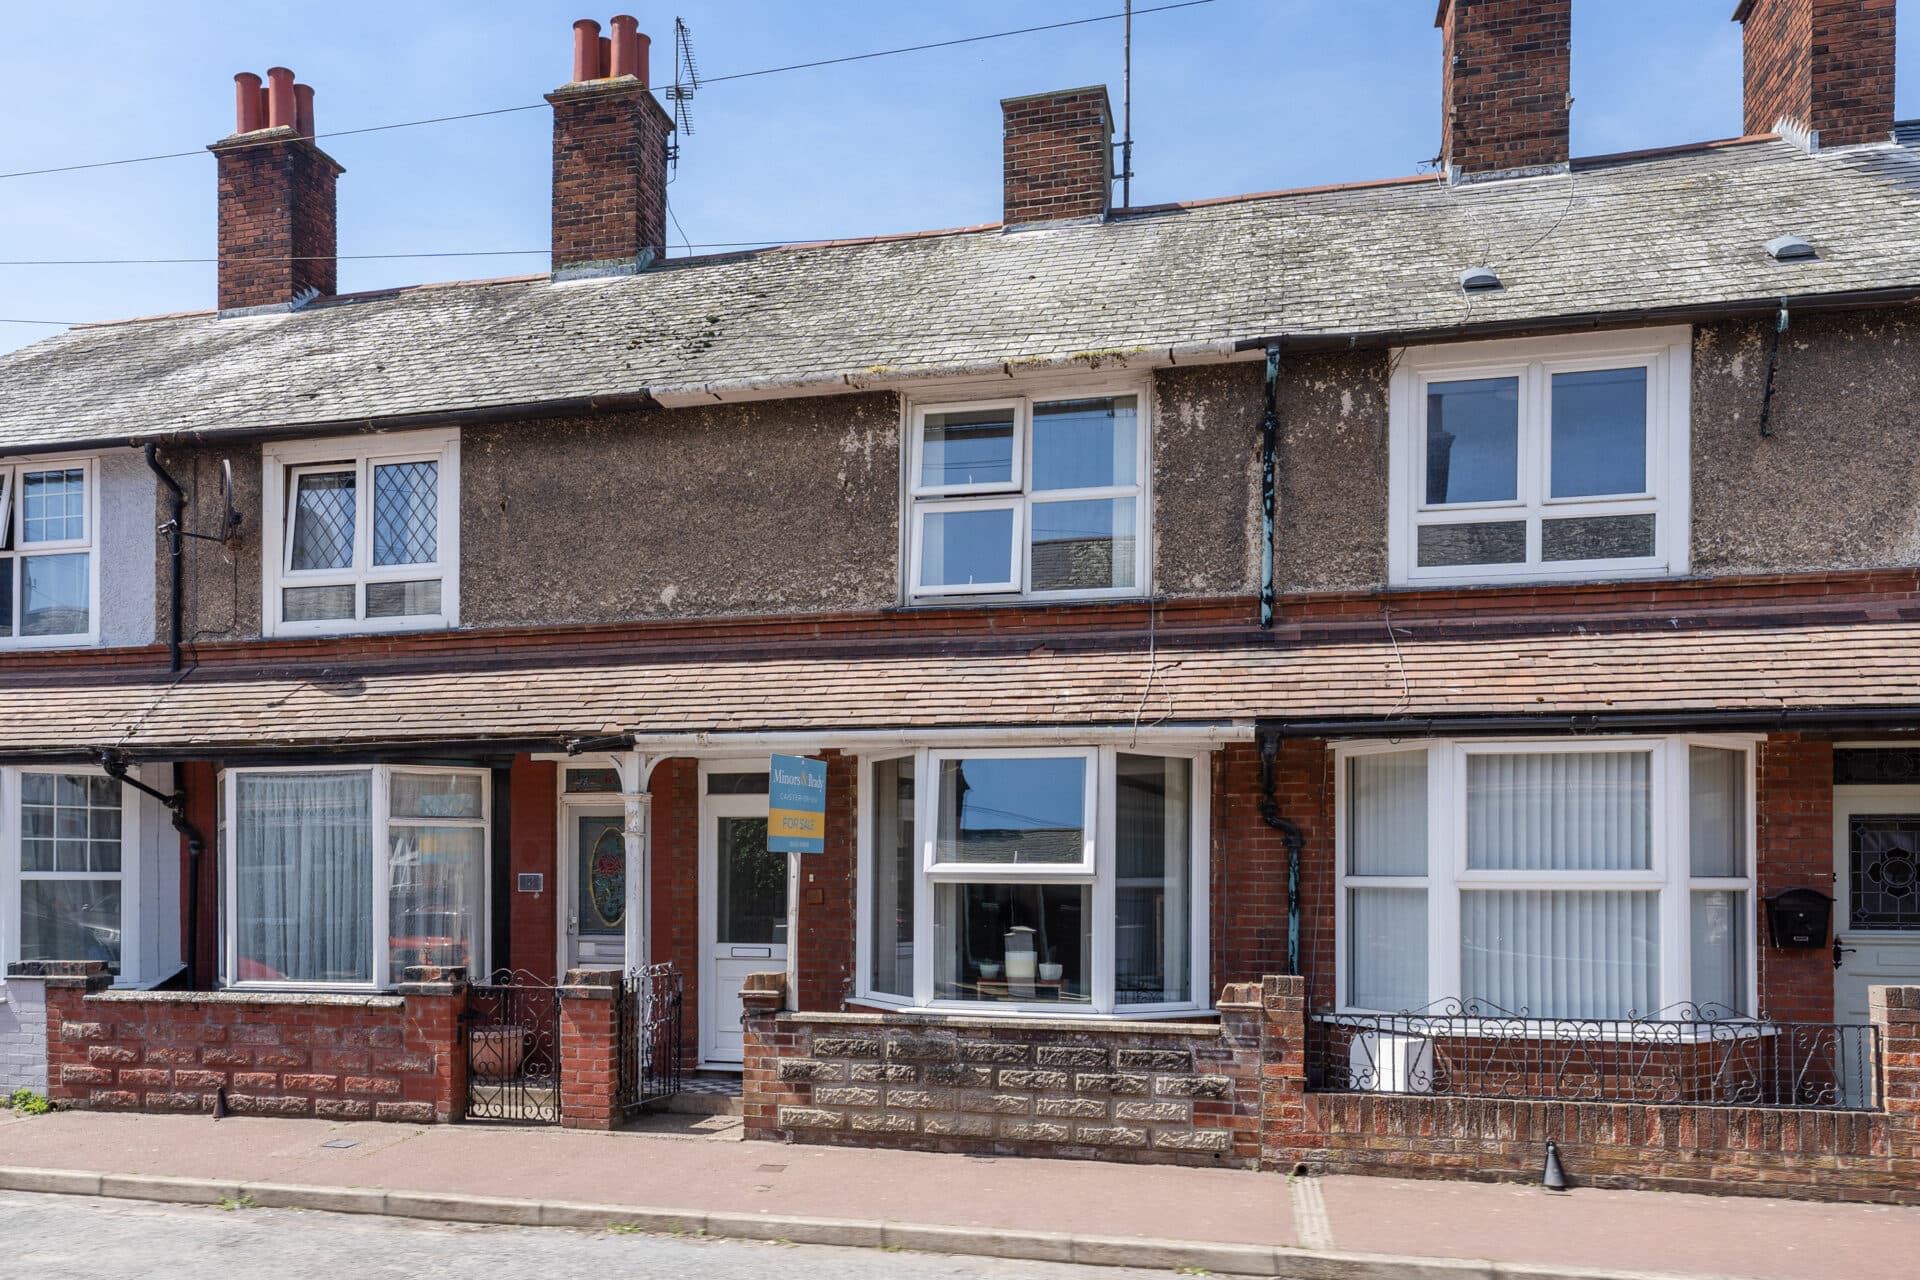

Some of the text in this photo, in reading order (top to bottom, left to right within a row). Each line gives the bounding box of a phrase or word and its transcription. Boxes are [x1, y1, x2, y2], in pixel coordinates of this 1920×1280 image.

[773, 768, 800, 785] Minors
[783, 816, 815, 831] FOR SALE
